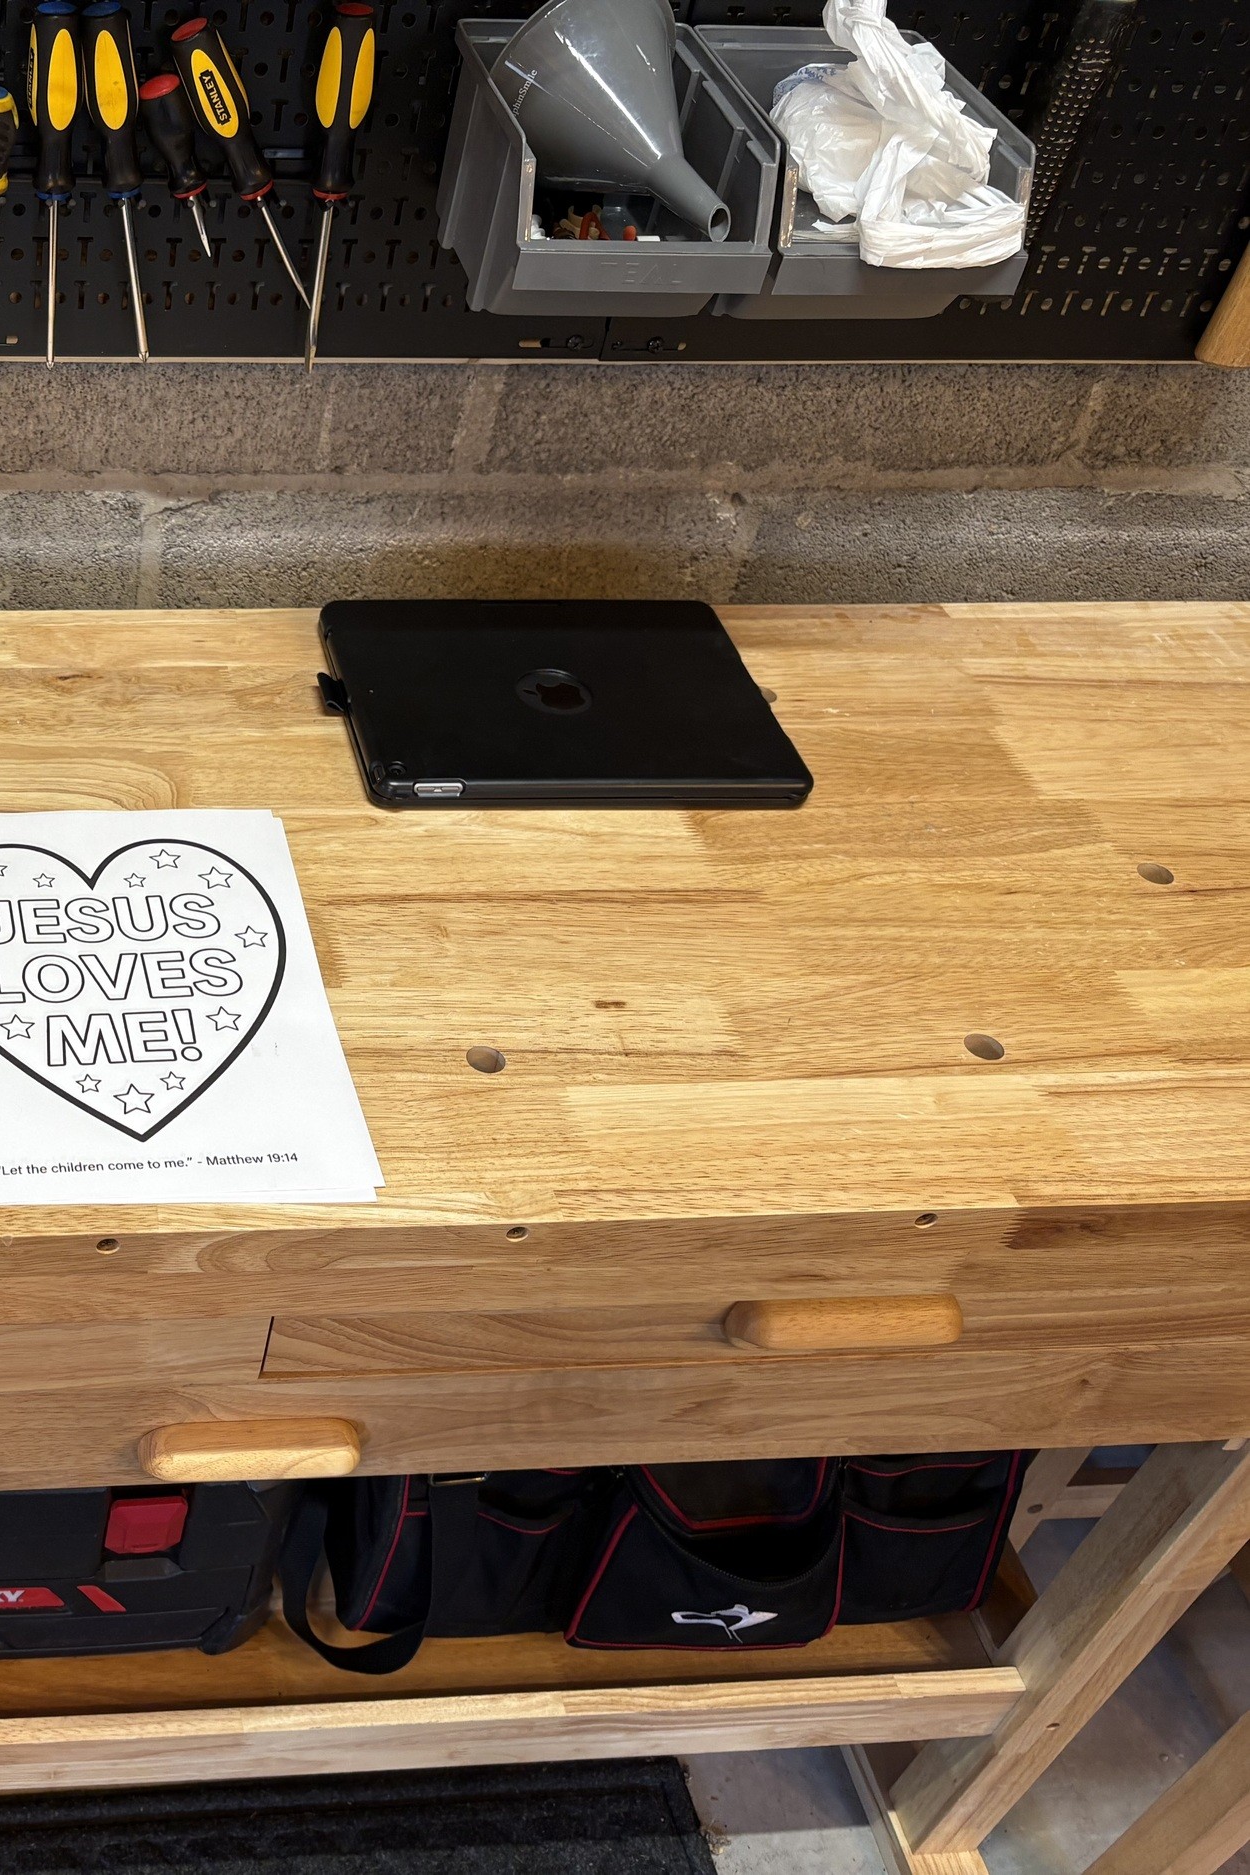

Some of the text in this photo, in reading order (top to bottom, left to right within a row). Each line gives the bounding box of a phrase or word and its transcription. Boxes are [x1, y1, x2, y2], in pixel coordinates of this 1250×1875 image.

[202, 74, 228, 121] STANLEY
[46, 1008, 202, 1068] ME!
[26, 1164, 48, 1174] the
[51, 1162, 104, 1174] children
[108, 1162, 144, 1171] come
[147, 1160, 161, 1169] to
[164, 1156, 192, 1168] me.”
[206, 1154, 264, 1166] Matthew
[266, 1152, 298, 1164] 19:14
